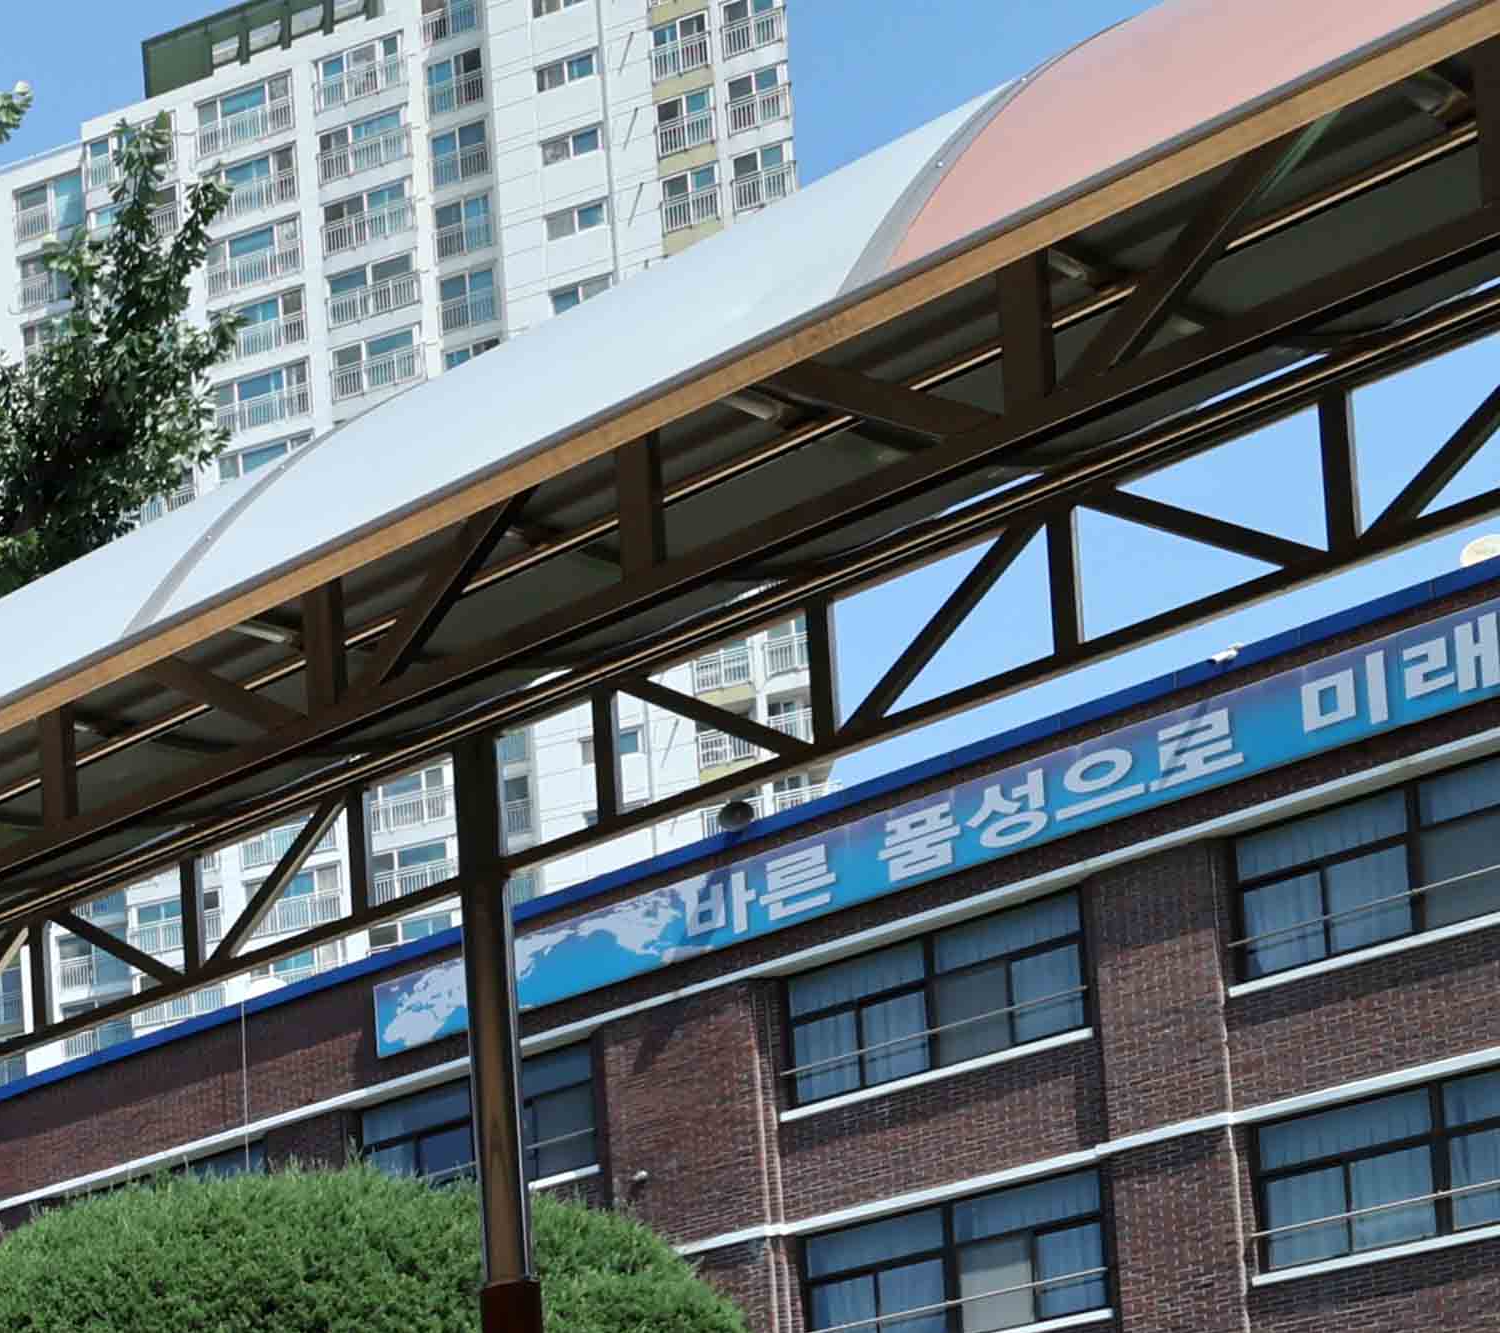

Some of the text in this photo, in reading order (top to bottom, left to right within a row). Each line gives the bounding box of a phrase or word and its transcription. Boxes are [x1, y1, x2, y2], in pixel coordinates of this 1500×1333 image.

[683, 611, 1500, 938] 바른 품성으로 미래
